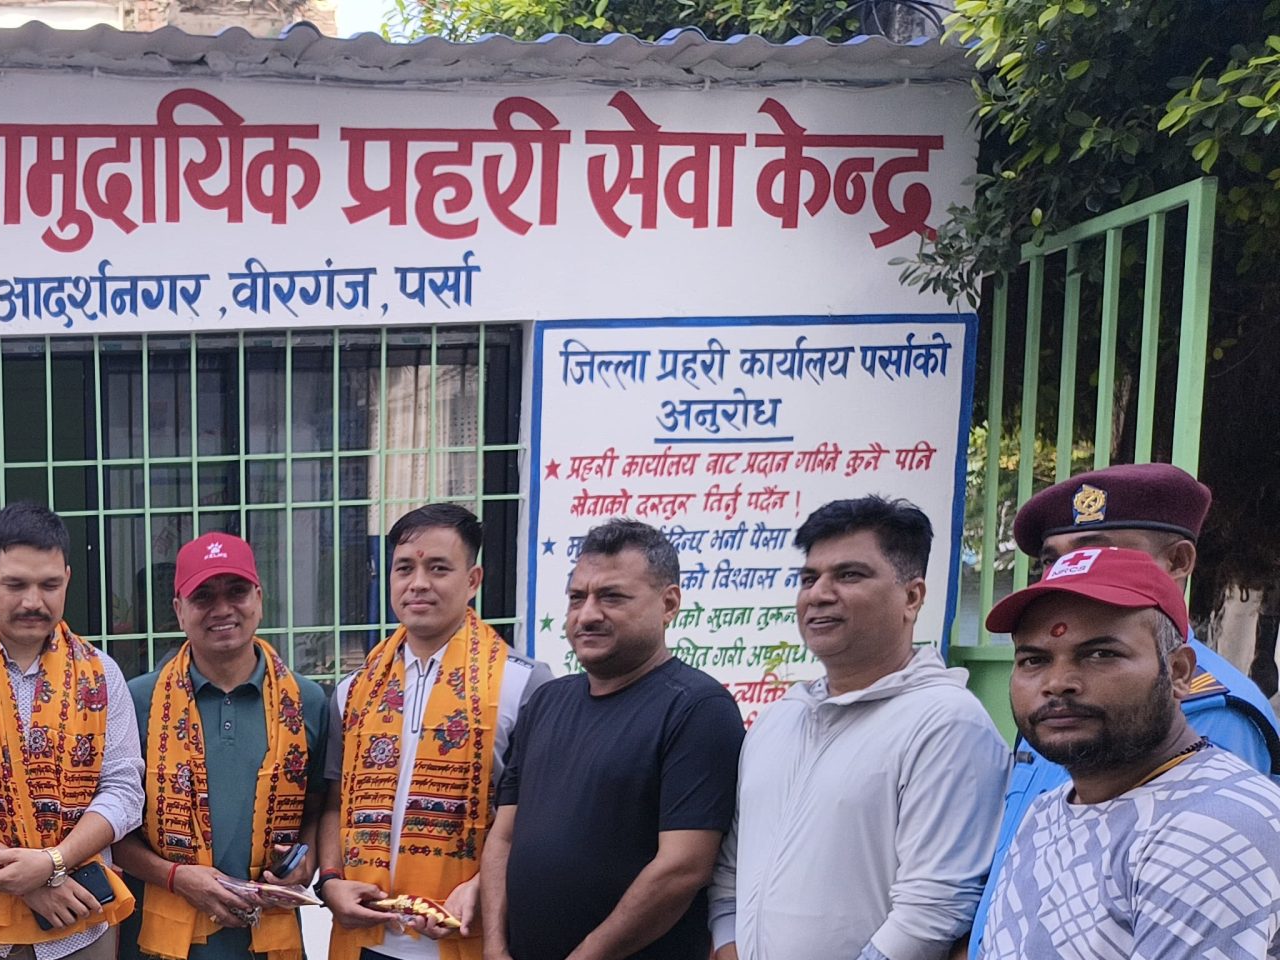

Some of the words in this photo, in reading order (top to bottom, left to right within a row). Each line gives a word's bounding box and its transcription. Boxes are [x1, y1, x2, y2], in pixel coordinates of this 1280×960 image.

[340, 96, 571, 239] प्रहरी
[586, 91, 746, 238] सेवा
[756, 97, 944, 248] केन्द्र
[395, 250, 481, 309] पर्सा
[559, 339, 651, 390] जिल्ला
[656, 338, 730, 390] प्रहरी
[739, 336, 854, 386] कार्यालय
[860, 332, 952, 381] पर्साको
[656, 388, 782, 433] अनुरोध
[566, 447, 619, 482] प्रहरी
[622, 446, 701, 477] कार्यालय
[895, 440, 937, 471] पनि
